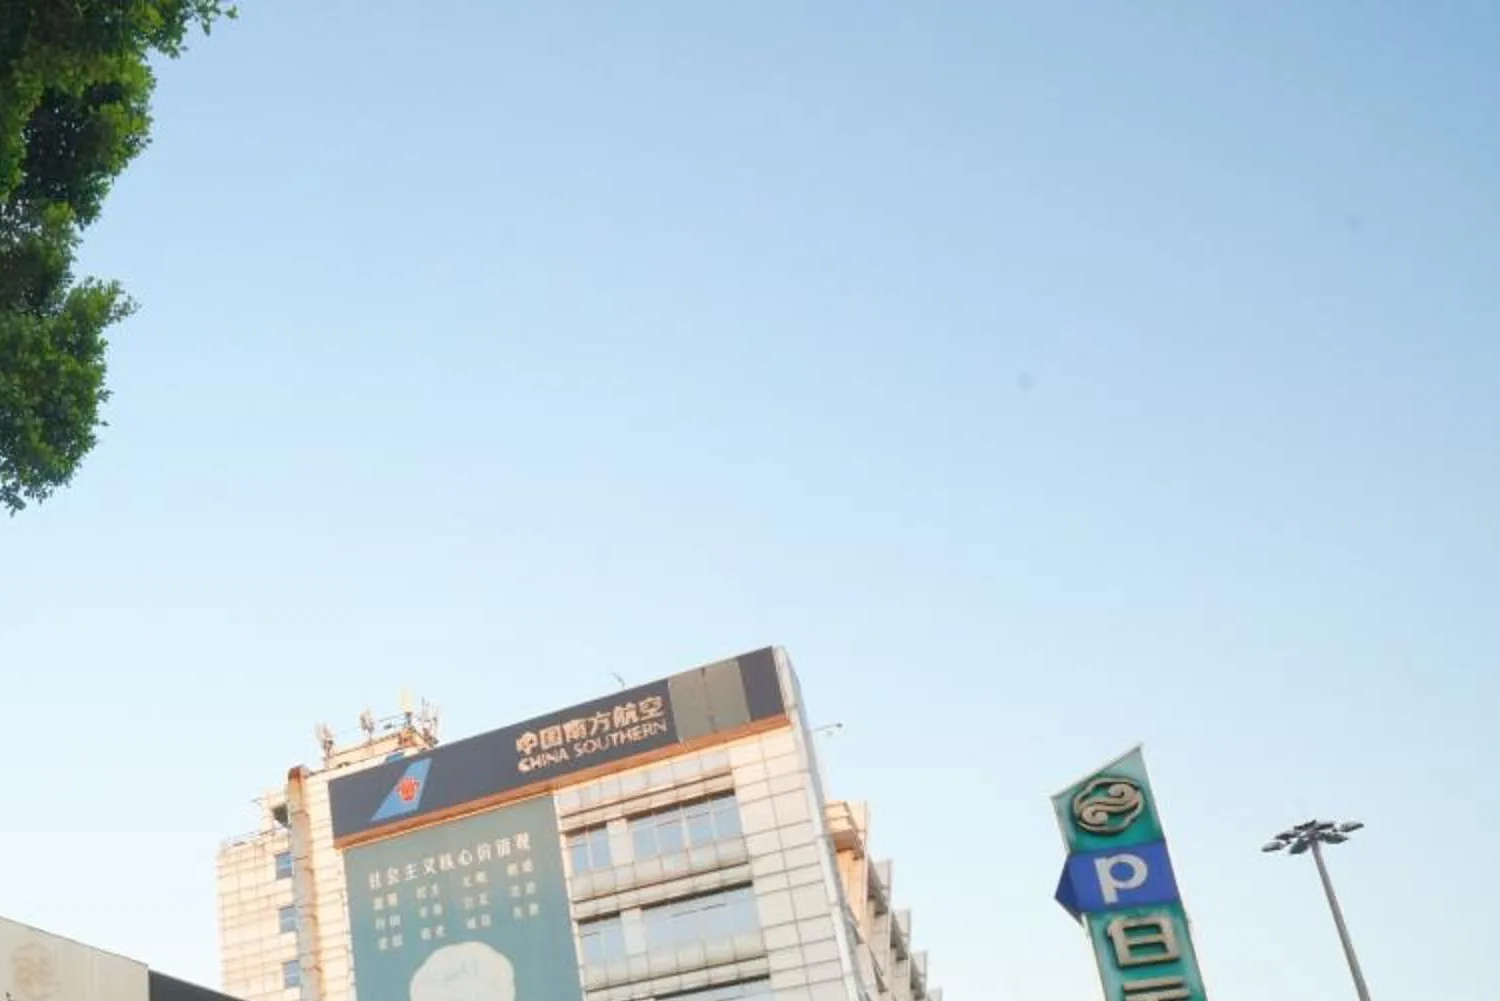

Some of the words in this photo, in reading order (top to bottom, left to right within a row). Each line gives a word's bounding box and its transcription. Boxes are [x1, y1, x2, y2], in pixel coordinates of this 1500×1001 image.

[516, 696, 665, 755] 中国南方航空
[518, 747, 570, 772] CHINA
[573, 718, 668, 758] SOUTHERN
[1094, 855, 1148, 904] P
